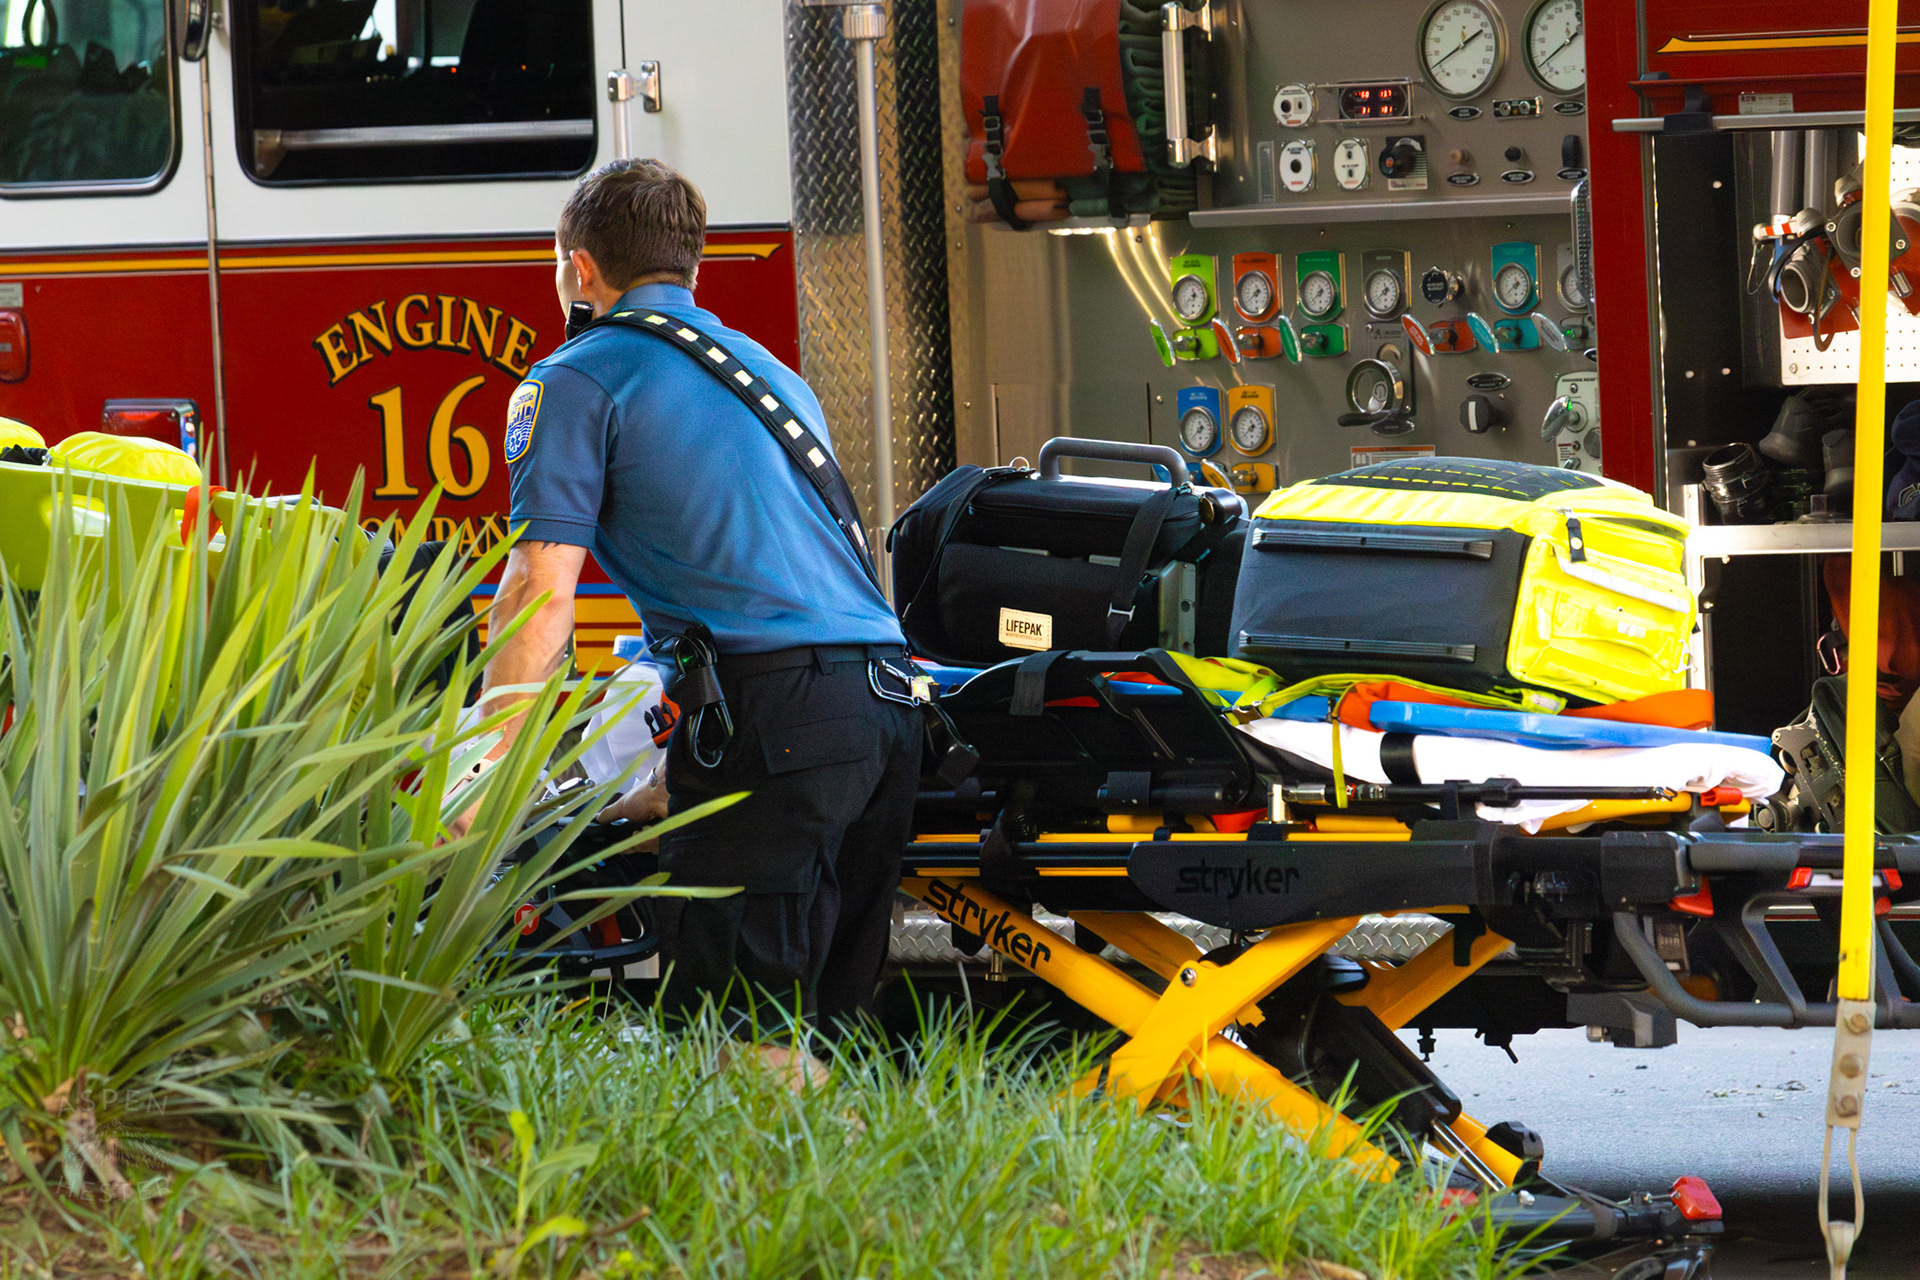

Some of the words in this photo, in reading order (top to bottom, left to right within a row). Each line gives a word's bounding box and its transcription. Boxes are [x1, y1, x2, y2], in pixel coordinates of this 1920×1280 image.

[312, 293, 537, 388] ENGINE
[367, 375, 490, 501] 16
[1006, 619, 1042, 636] LIFEPAK
[1175, 858, 1300, 898] stryker
[922, 879, 1052, 970] stryker
